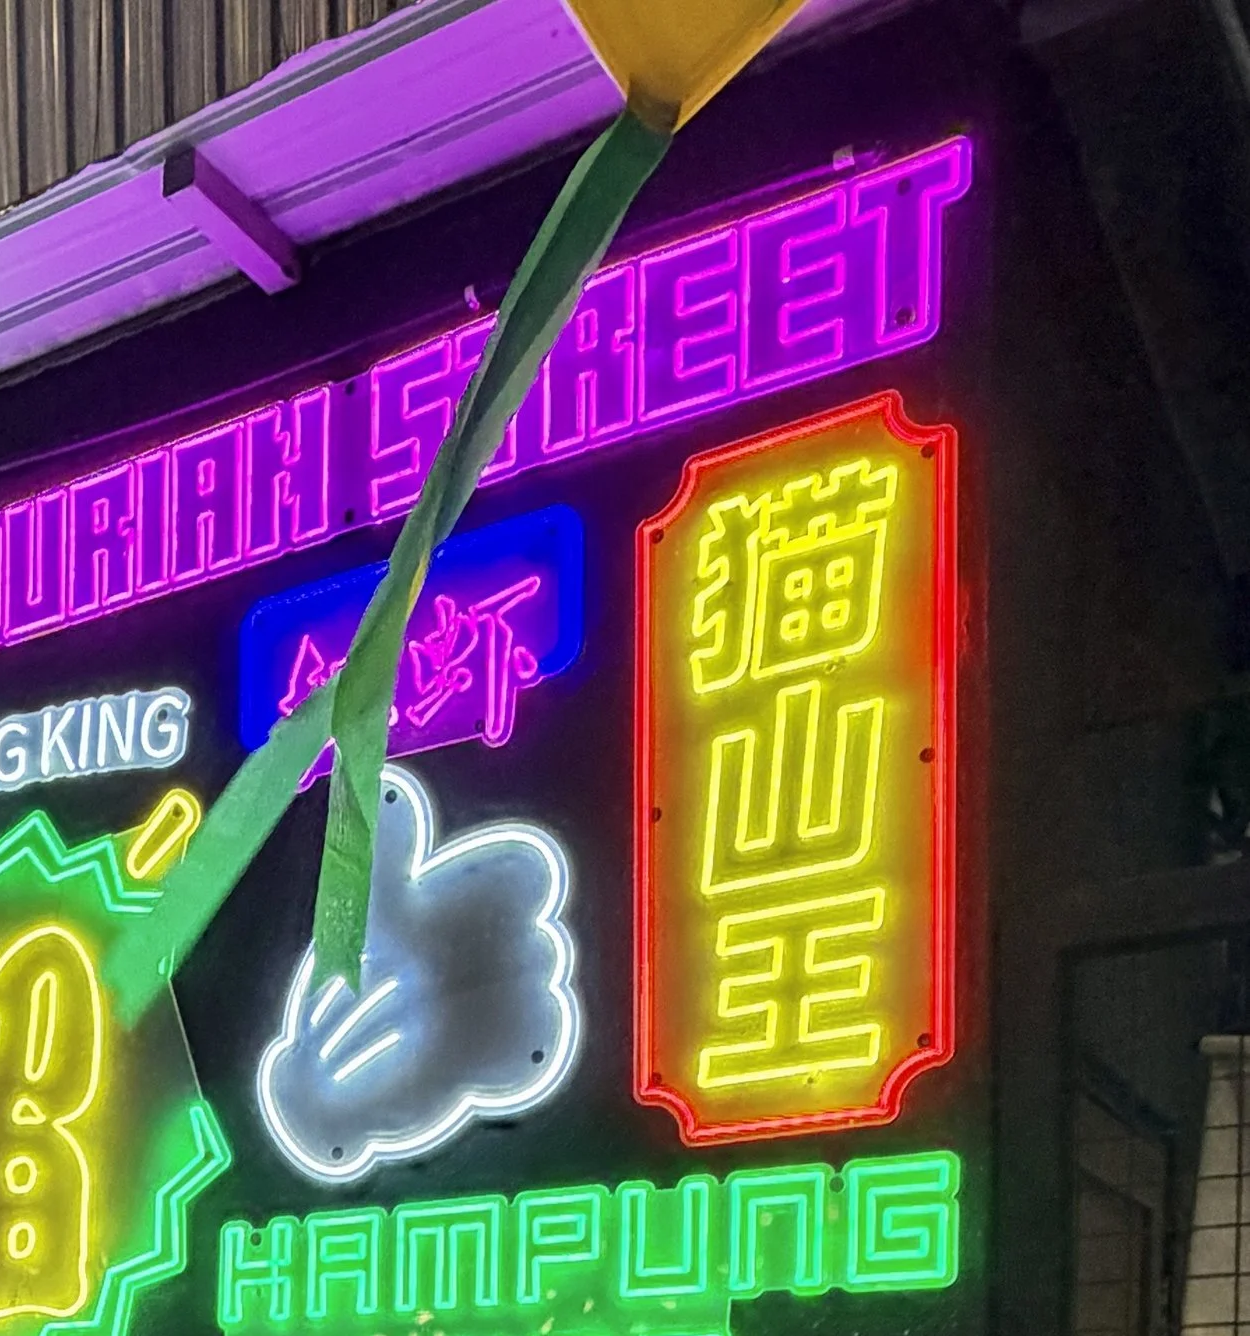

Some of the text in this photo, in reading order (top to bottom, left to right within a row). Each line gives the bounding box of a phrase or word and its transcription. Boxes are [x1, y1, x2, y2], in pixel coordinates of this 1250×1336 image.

[41, 692, 190, 776] KING
[688, 457, 900, 1090] 猫山王
